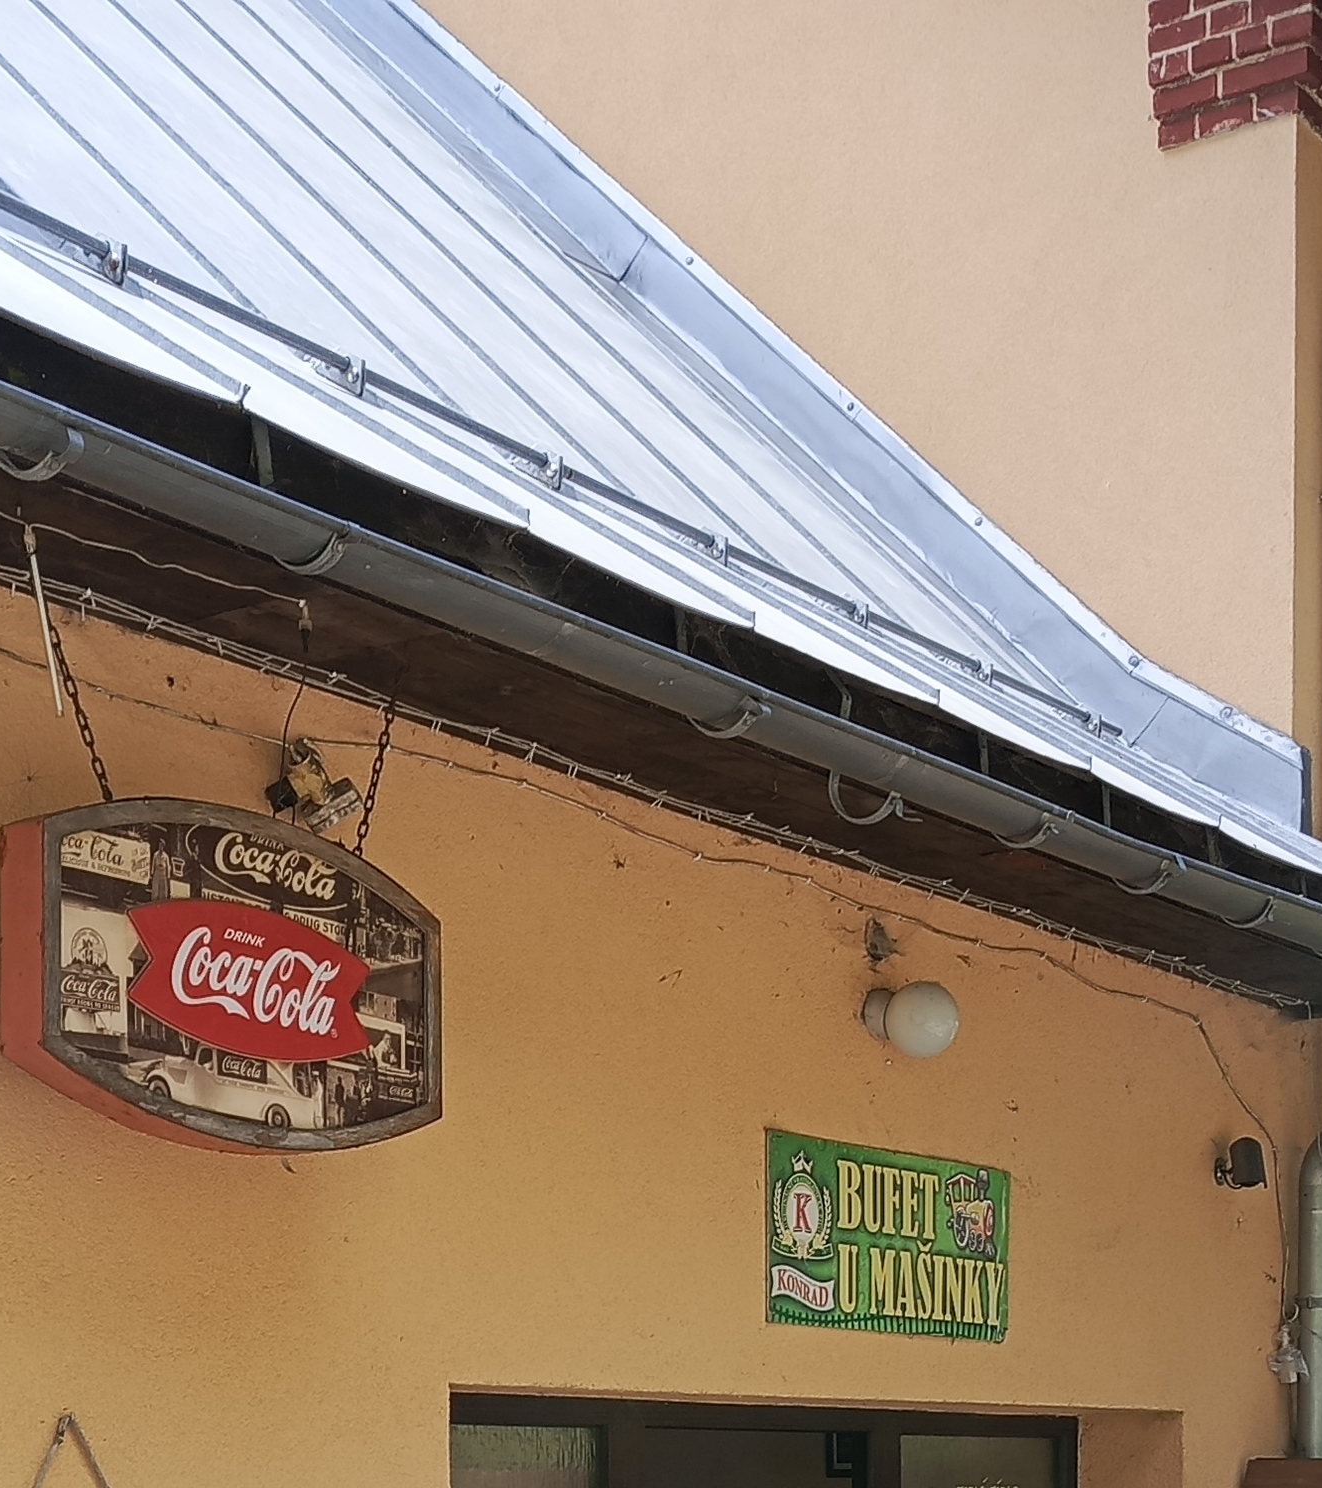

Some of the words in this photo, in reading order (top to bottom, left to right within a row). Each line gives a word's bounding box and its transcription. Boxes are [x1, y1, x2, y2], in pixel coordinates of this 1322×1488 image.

[224, 928, 266, 948] DRINK
[793, 1193, 812, 1234] K
[837, 1159, 940, 1240] BUFET
[777, 1269, 828, 1307] KONRAD
[838, 1244, 858, 1313] U
[870, 1240, 1005, 1326] MAŠINKY
